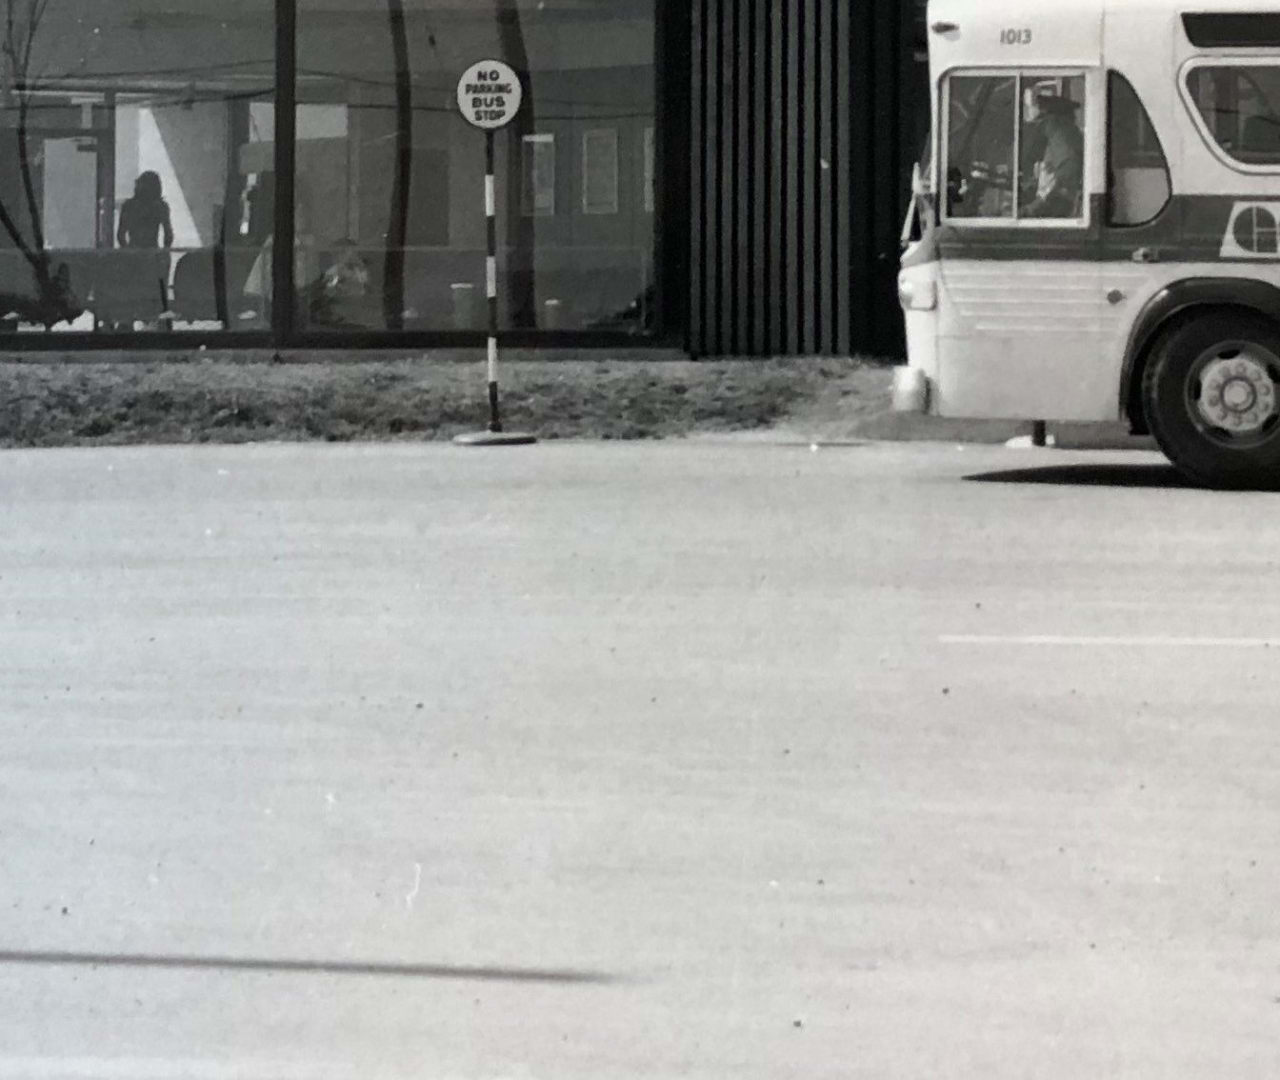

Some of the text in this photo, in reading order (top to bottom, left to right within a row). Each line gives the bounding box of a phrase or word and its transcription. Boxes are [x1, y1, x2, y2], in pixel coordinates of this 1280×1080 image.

[1000, 28, 1032, 45] 1013
[477, 69, 500, 82] NO
[465, 83, 512, 94] PARKING
[472, 96, 506, 108] BUS
[474, 109, 506, 121] STOP
